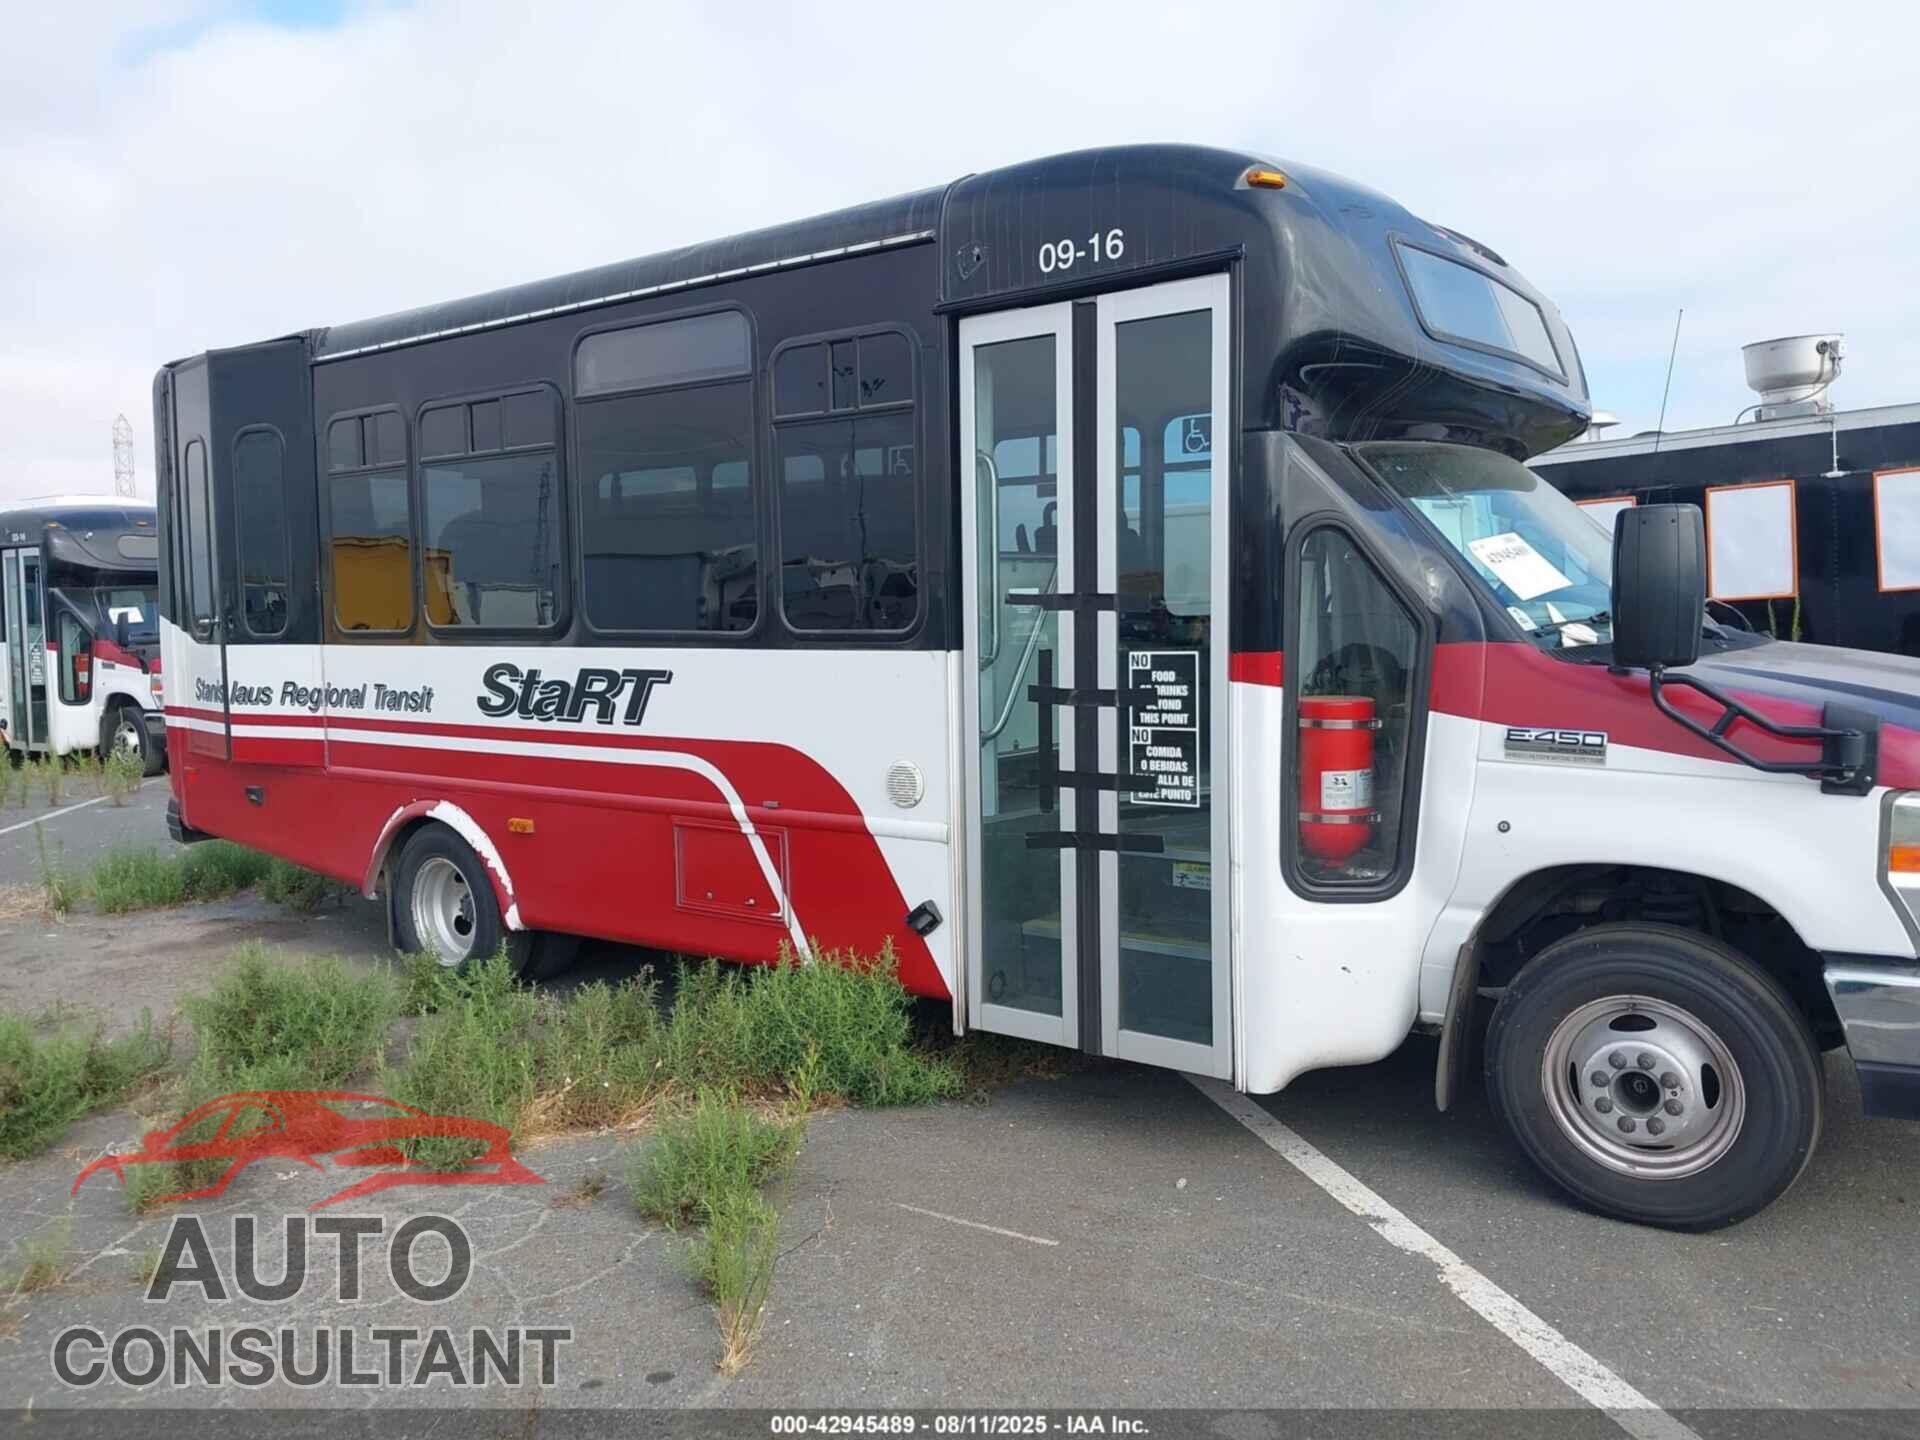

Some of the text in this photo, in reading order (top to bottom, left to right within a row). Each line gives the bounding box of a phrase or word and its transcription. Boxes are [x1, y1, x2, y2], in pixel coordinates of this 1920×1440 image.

[1039, 228, 1124, 273] 09-16
[1132, 654, 1149, 668] NO
[1151, 670, 1176, 682] FOOD
[280, 681, 367, 713] Regional
[373, 683, 434, 713] Transit
[477, 662, 673, 727] StaRT
[1139, 712, 1189, 725] THIS POINT
[1132, 728, 1149, 743] NO
[1146, 746, 1182, 758] COMIDA
[1149, 760, 1188, 773] BEBIDAS
[1157, 774, 1180, 786] ALLA
[1181, 775, 1195, 787] DE
[1161, 788, 1192, 801] PUNTO
